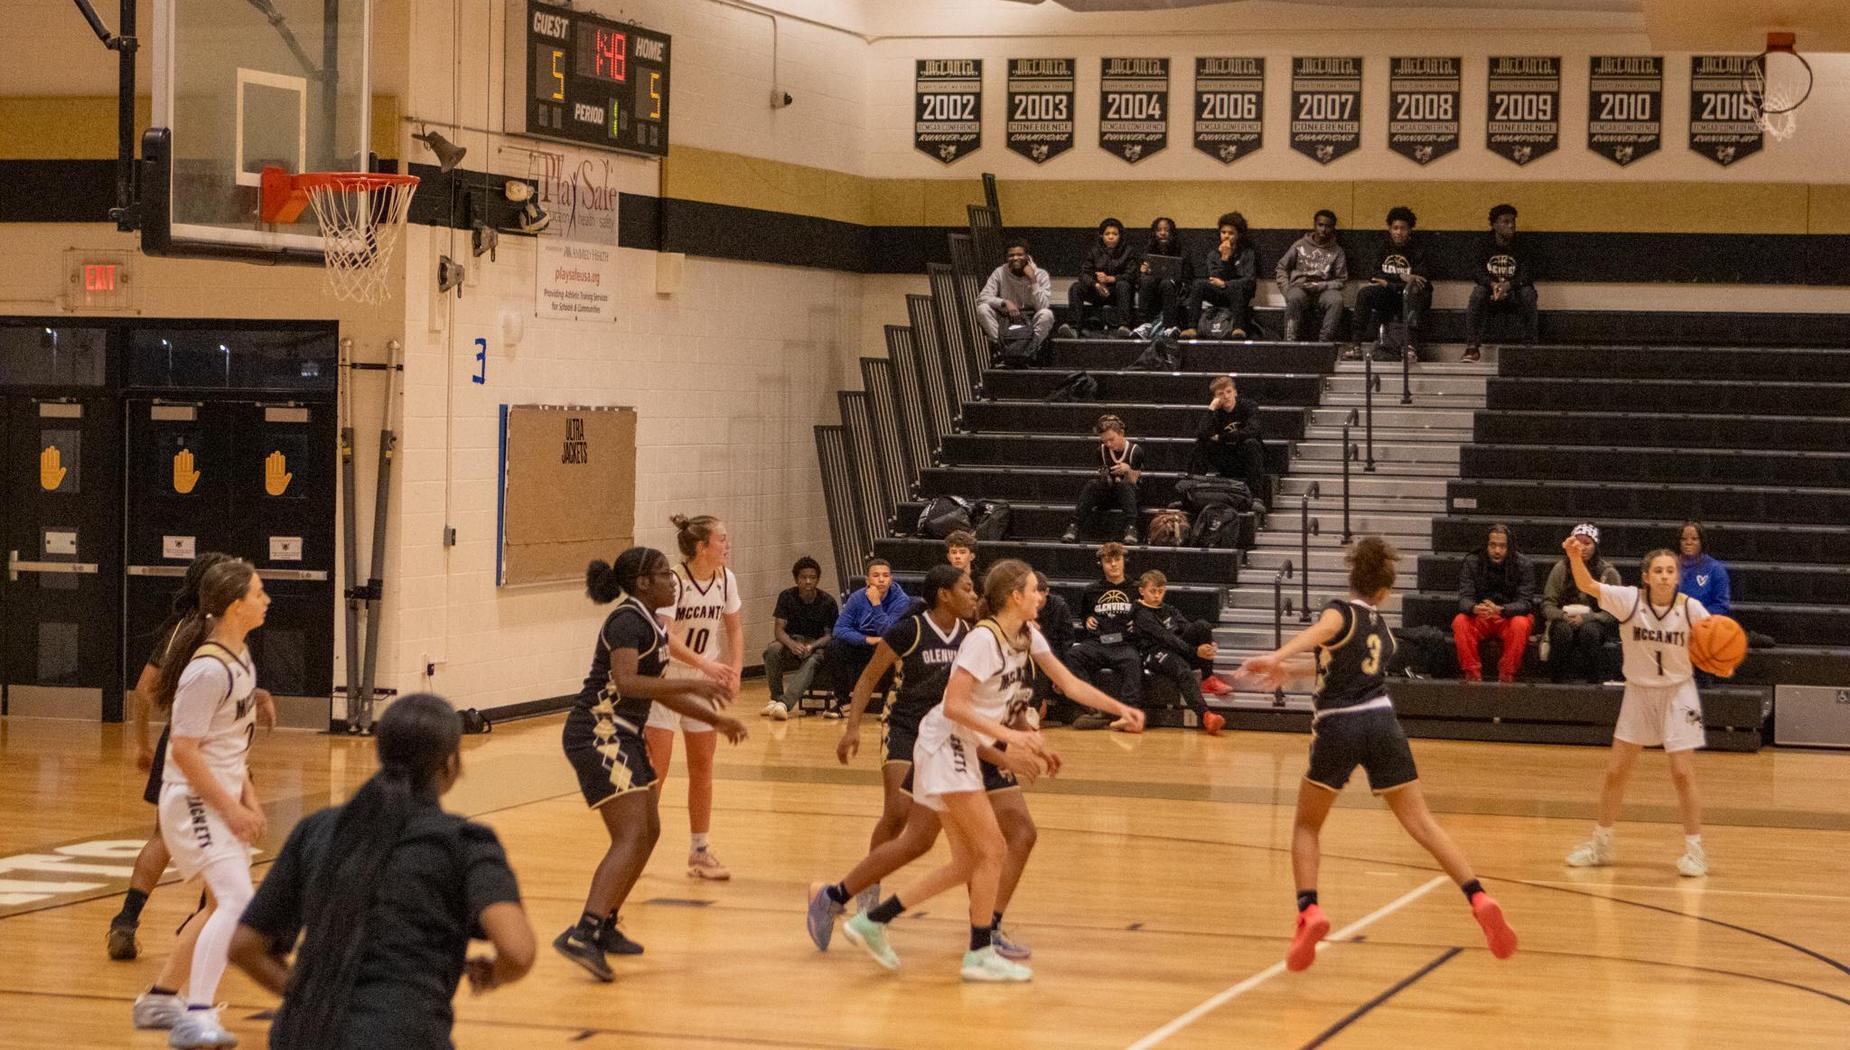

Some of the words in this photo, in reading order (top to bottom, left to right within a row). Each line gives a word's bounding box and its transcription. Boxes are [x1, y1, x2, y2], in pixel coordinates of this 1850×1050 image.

[533, 12, 568, 40] GUEST
[636, 37, 664, 62] HOME
[552, 50, 564, 100] 5
[650, 72, 660, 119] 5
[922, 95, 974, 120] 2002
[1014, 95, 1067, 120] 2003
[1108, 94, 1160, 119] 2004
[1202, 94, 1256, 118] 2006
[1299, 94, 1354, 120] 2007
[1397, 94, 1452, 120] 2008
[1495, 94, 1551, 120] 2009
[1600, 94, 1650, 120] 2010
[574, 104, 605, 125] PERIOD
[613, 99, 618, 137] 1
[1294, 123, 1356, 131] CONFERENCE
[85, 264, 115, 290] EXIT
[555, 266, 600, 287] playsafeusa.org
[544, 288, 564, 300] Providing
[472, 338, 487, 385] 3
[565, 418, 585, 441] ULTRA
[561, 442, 588, 464] JACKETS
[1094, 602, 1132, 612] GLENVIEW
[684, 628, 710, 654] 10
[1632, 626, 1685, 646] MCCANTS
[1361, 634, 1381, 676] 3
[1655, 650, 1663, 676] 1
